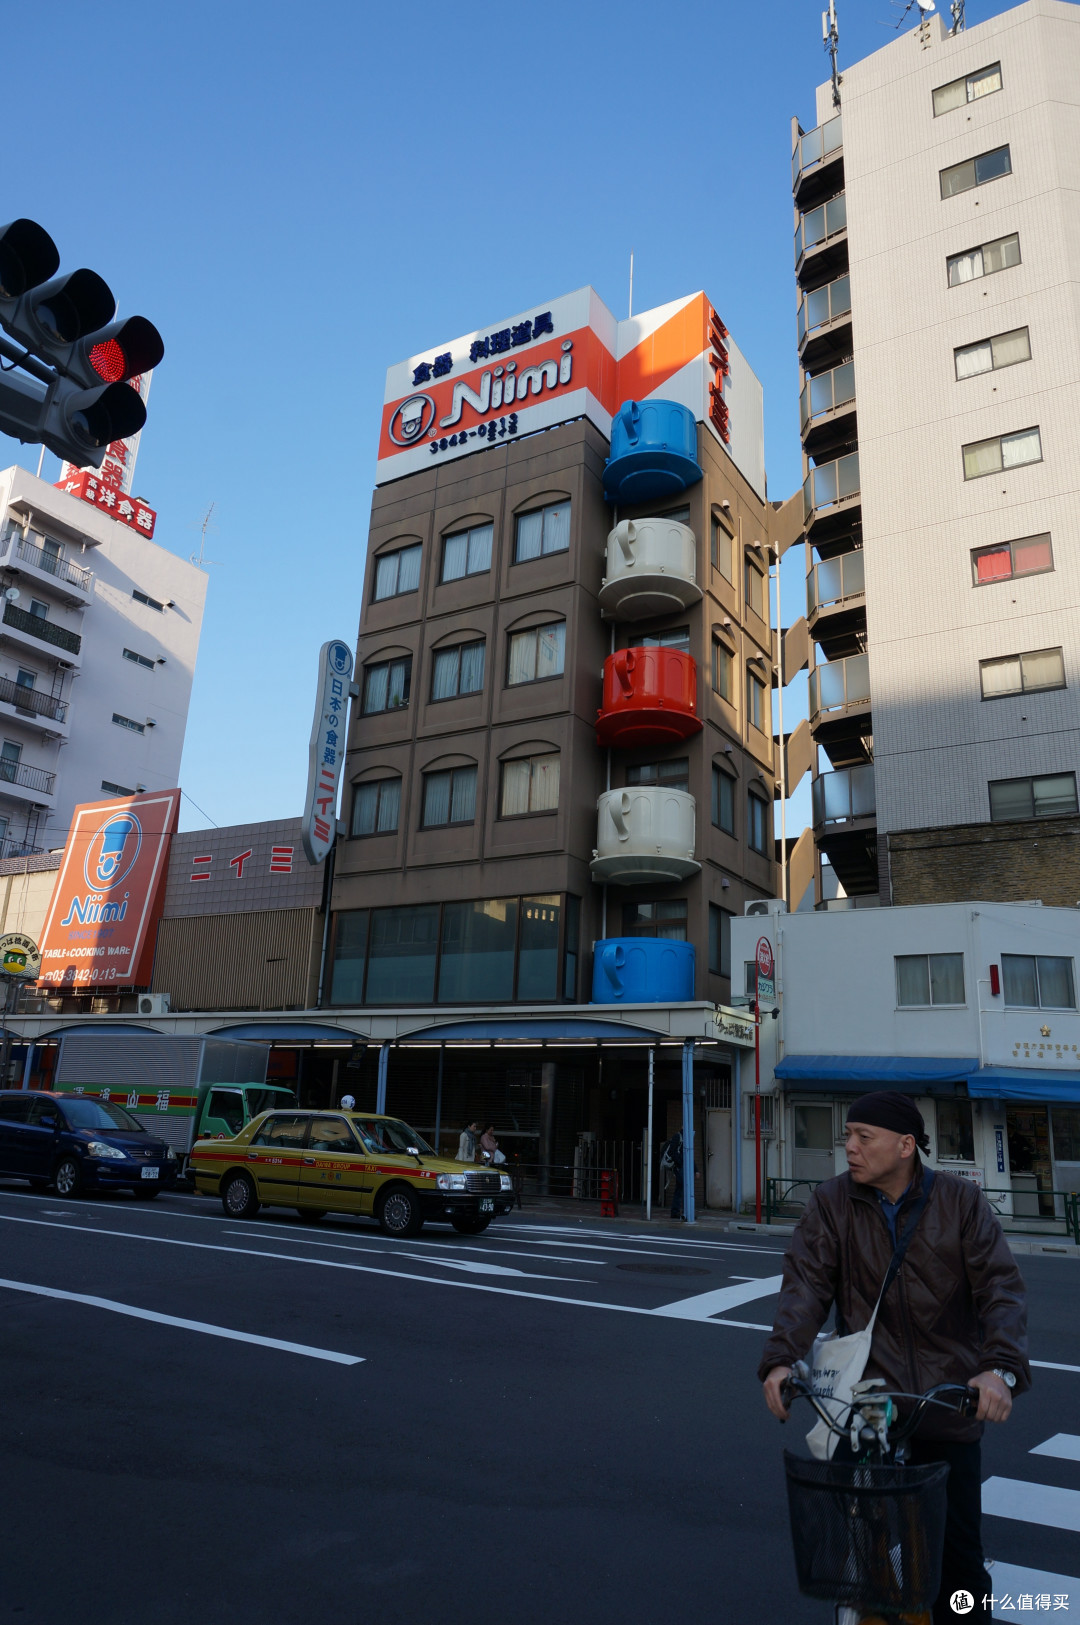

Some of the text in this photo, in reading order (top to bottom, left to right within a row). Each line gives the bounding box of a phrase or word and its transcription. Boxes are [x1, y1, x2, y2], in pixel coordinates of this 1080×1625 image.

[469, 311, 554, 363] 料理道具
[439, 339, 574, 429] Niimi
[708, 306, 730, 444] ニイミ
[99, 485, 153, 531] 洋食器
[189, 845, 294, 882] ニイミ
[61, 892, 131, 926] Niimi
